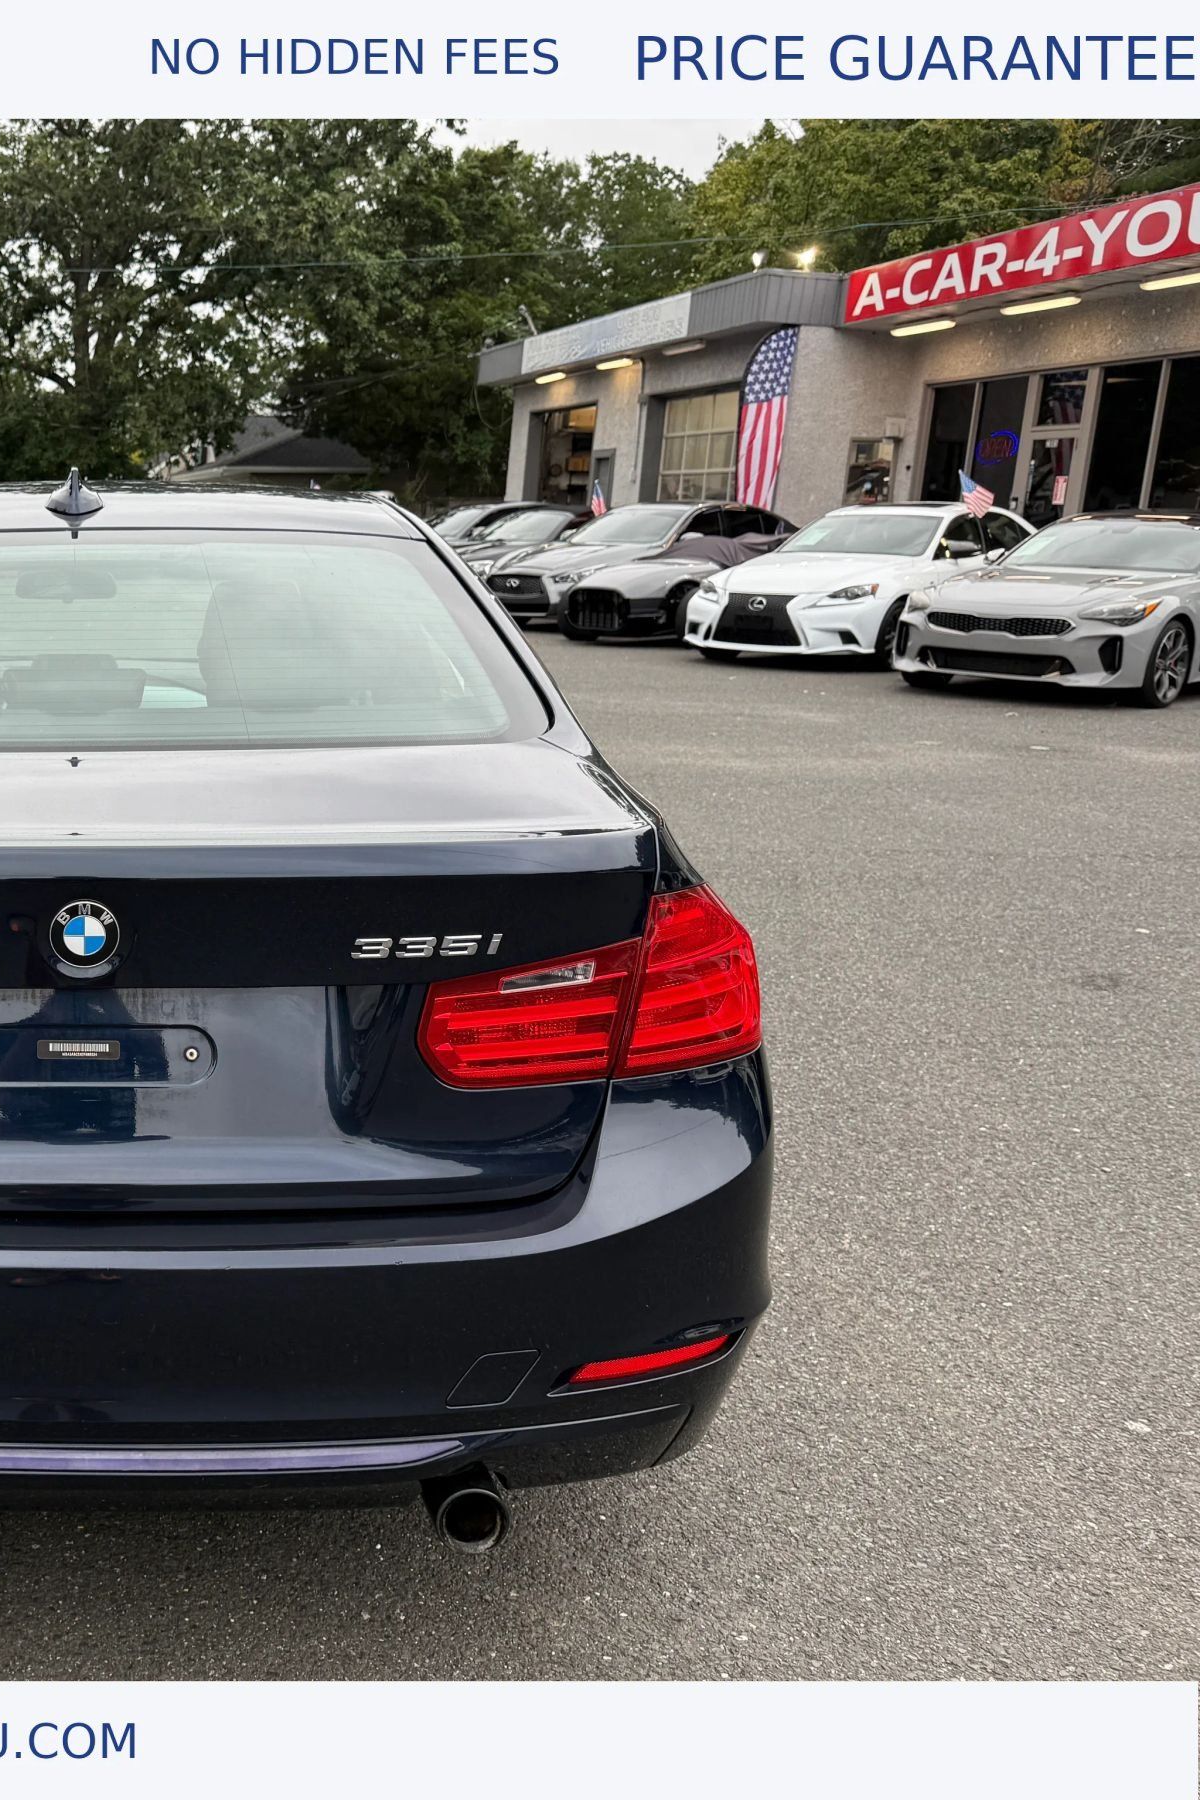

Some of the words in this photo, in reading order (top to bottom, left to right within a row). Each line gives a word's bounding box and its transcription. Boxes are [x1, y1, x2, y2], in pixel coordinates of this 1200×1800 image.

[851, 192, 1200, 317] A-CAR-4-YO
[56, 903, 114, 926] BMW
[351, 933, 503, 960] 335i
